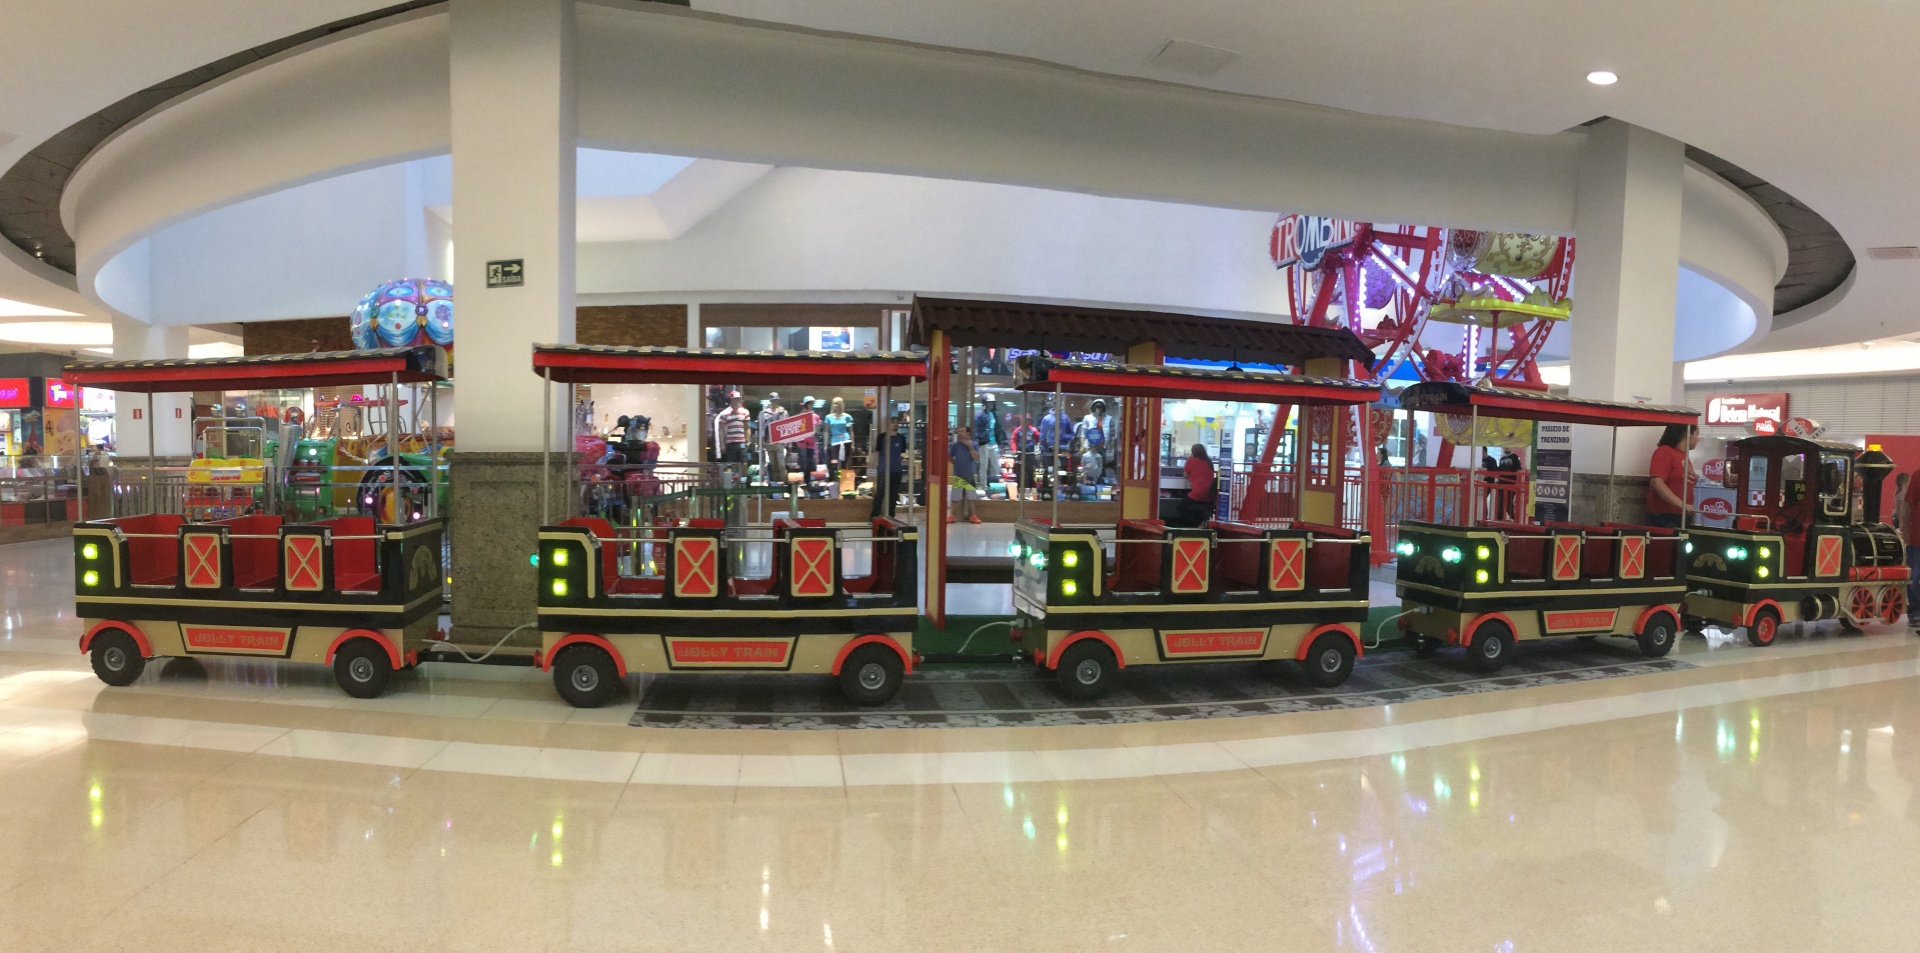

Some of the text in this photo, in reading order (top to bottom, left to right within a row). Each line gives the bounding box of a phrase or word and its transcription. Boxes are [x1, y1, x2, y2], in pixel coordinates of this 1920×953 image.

[1811, 427, 1826, 439] ENTO
[1540, 436, 1570, 444] TRENZINHO
[1794, 483, 1806, 492] PA
[1582, 616, 1610, 626] TRAIN
[238, 635, 279, 646] TRAIN
[1218, 635, 1257, 646] TRAIN
[733, 646, 779, 658] TRAIN
